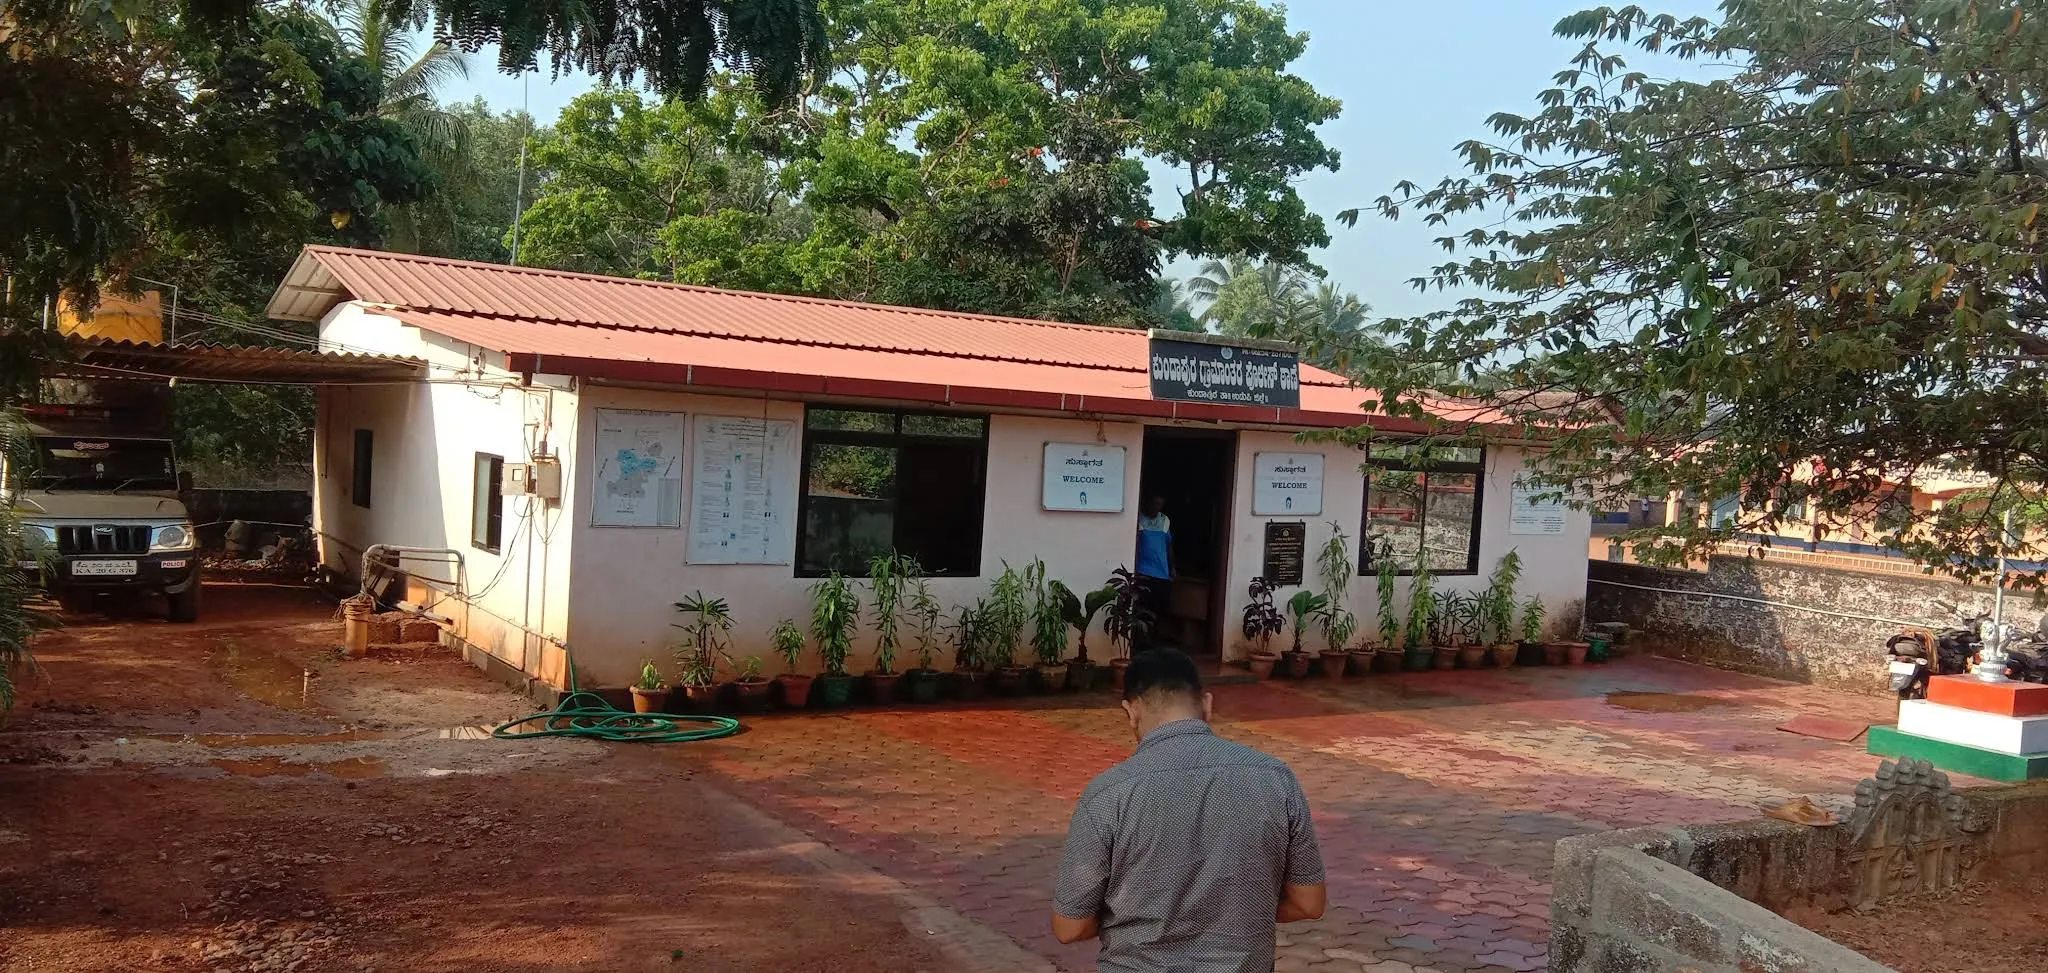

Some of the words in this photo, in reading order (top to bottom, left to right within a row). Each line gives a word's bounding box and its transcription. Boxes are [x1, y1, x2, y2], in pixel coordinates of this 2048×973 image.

[1152, 353, 1197, 387] ಕುಂದಾಪುರ
[1199, 358, 1243, 388] ಗ್ರಾಮಾಂತರ
[1065, 458, 1103, 468] ಸುಸ್ವಾಗತ
[1062, 475, 1105, 484] WELCOME
